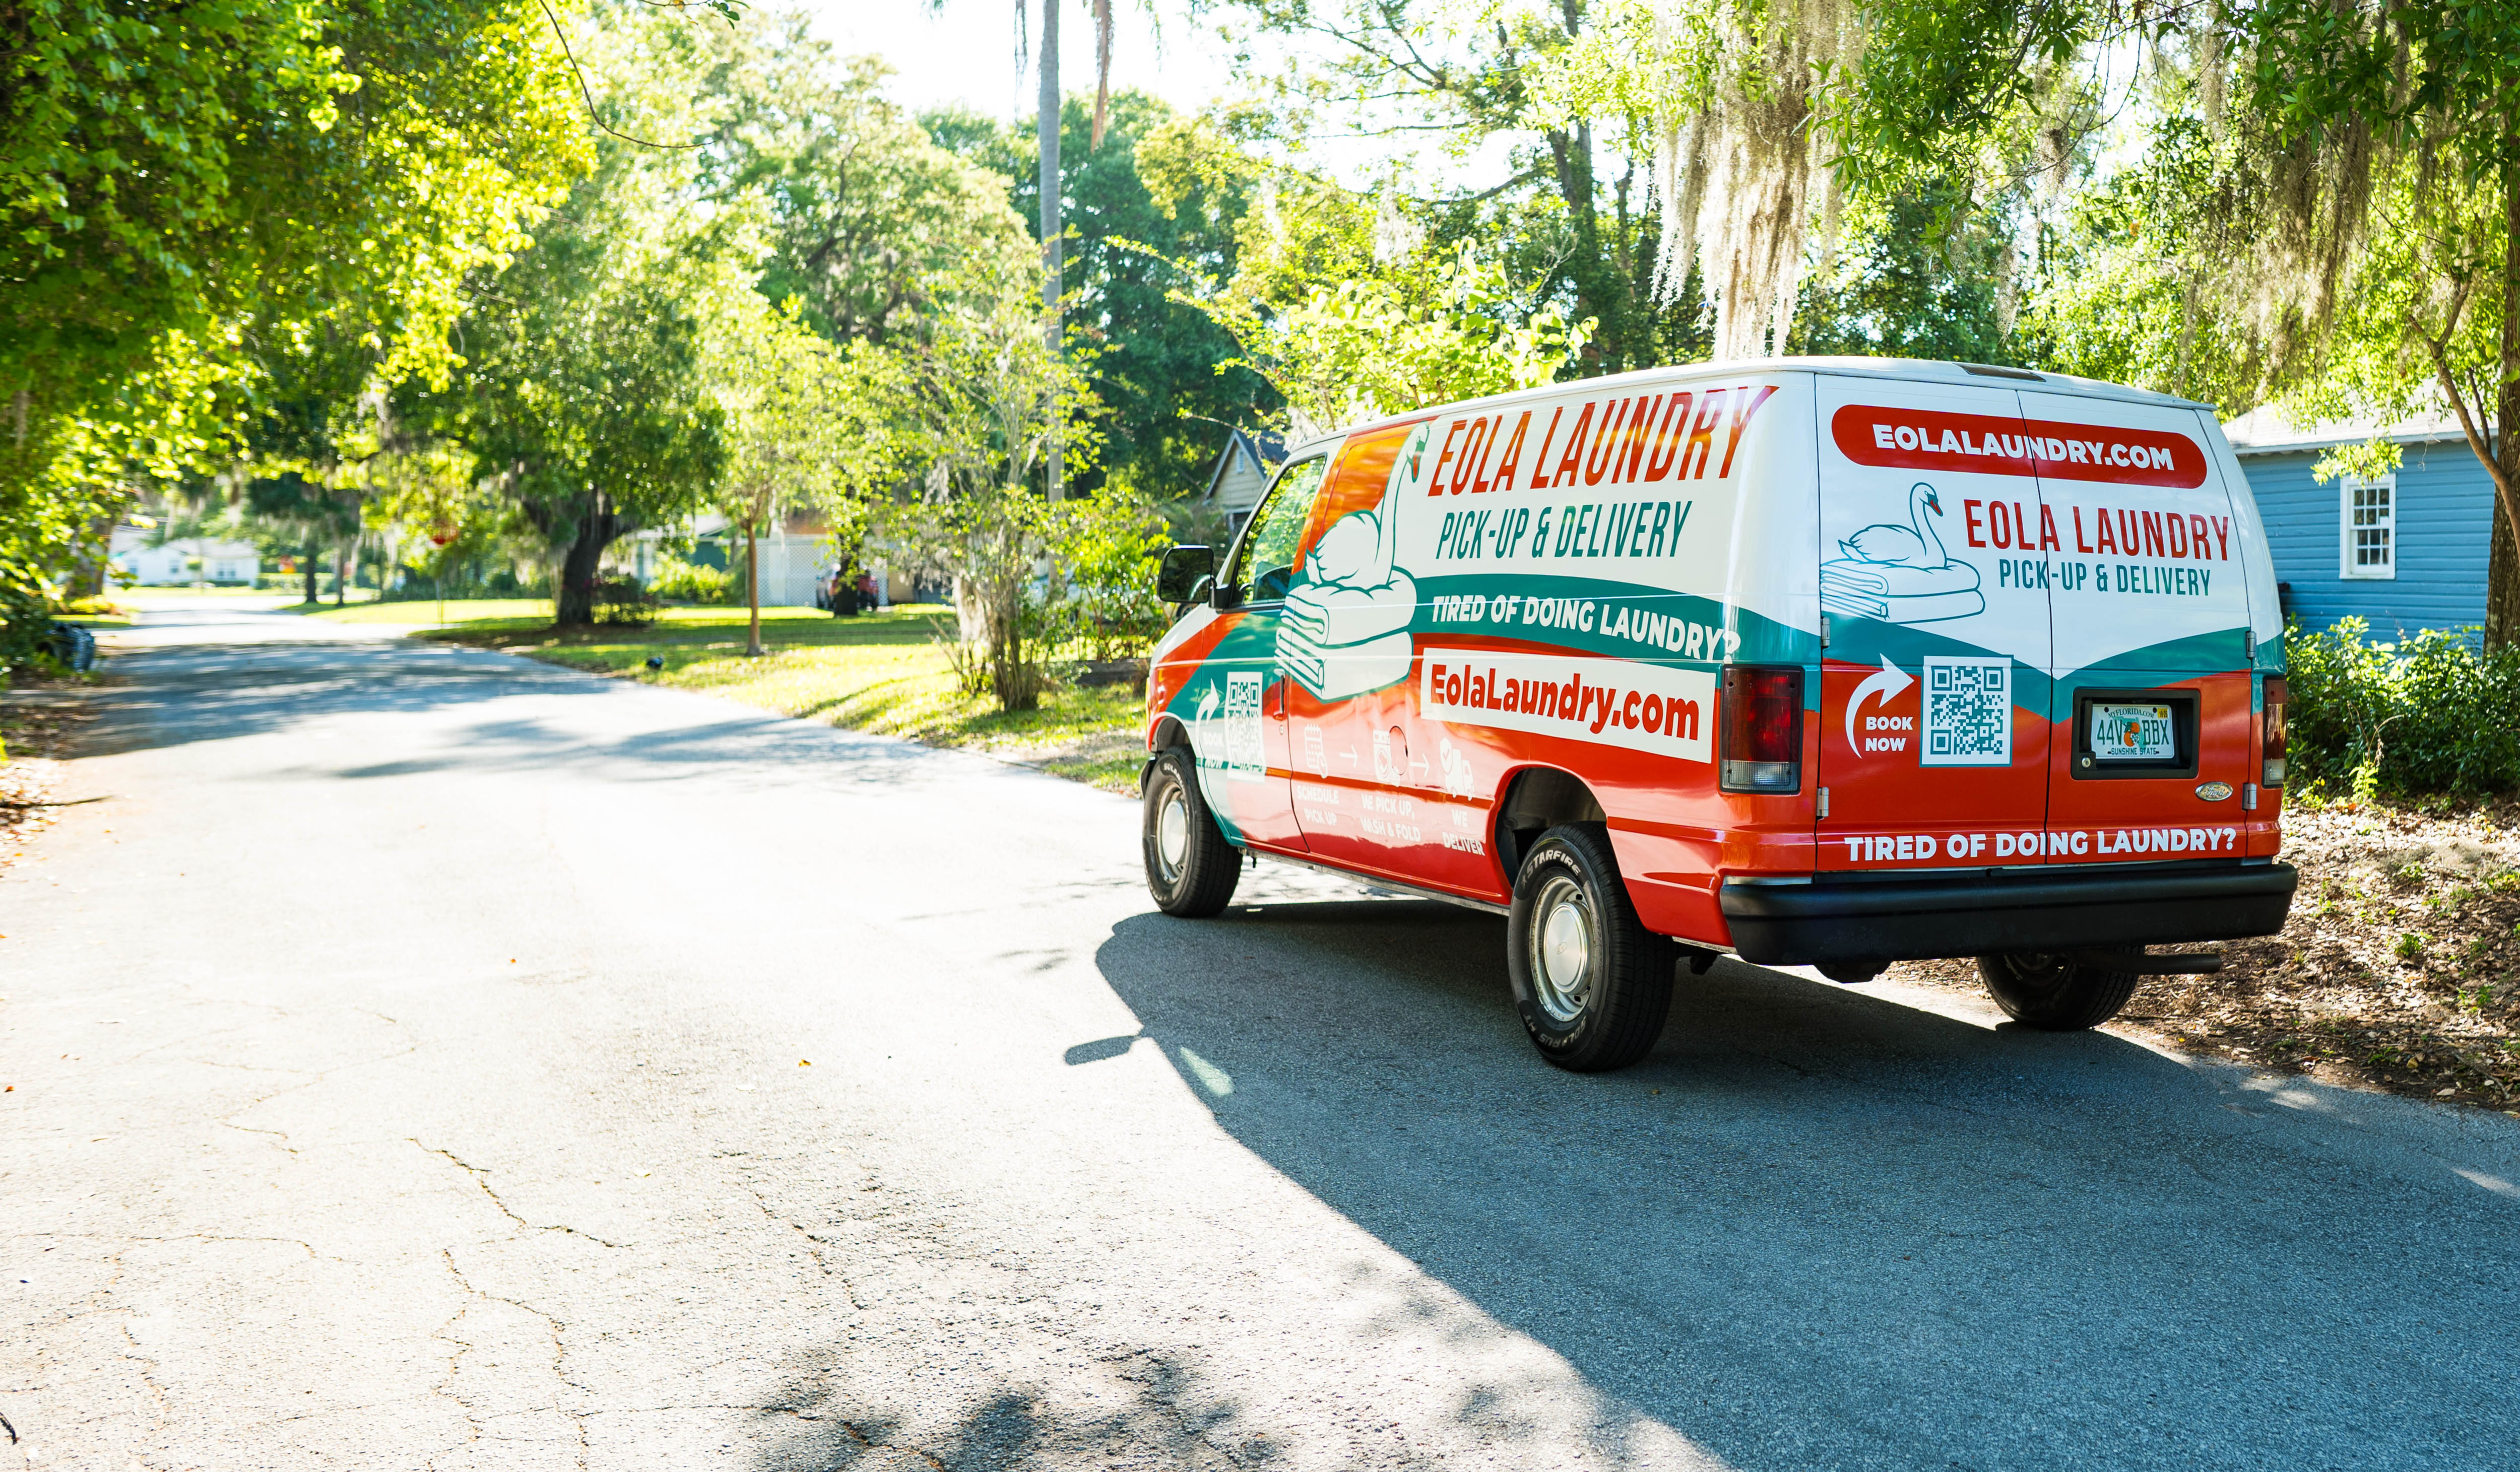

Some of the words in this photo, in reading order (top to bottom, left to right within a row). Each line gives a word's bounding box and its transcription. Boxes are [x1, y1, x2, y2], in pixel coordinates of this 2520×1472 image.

[1428, 411, 1532, 496] EOLA
[1530, 385, 1780, 489] LAUNDRY
[1872, 424, 2174, 471] EOLALAUNDRY.COM
[1436, 508, 1529, 559] PICK-UP
[1531, 506, 1552, 558] &
[1555, 501, 1693, 557] DELIVERY
[1963, 499, 2061, 552] EOLA
[2073, 506, 2229, 561] LAUNDRY
[1999, 559, 2087, 591] PICK-UP
[2096, 565, 2108, 592] &
[2117, 565, 2211, 596] DELIVERY
[1432, 595, 1485, 622] TIRED
[1491, 594, 1521, 624] OF
[1522, 596, 1595, 632] DOING
[1599, 605, 1741, 663] LAUNDRY?
[1431, 664, 1699, 741] EolaLaundry.com
[2108, 708, 2154, 718] MYFLORIDA.COM
[1866, 716, 1913, 730] BOOK
[2097, 719, 2123, 745] 44V
[2142, 720, 2169, 745] BBX
[1203, 732, 1224, 748] BOOK
[1865, 738, 1906, 751] NOW
[1205, 754, 1223, 769] NOW
[1297, 785, 1339, 805] SCHEDULE
[1361, 793, 1375, 810] WE
[1376, 796, 1397, 815] PICK
[1303, 808, 1324, 825] PICK
[1325, 811, 1337, 826] UP
[1361, 816, 1386, 835] WASH
[1386, 824, 1395, 837] &
[1395, 823, 1421, 842] FOLD
[1451, 808, 1468, 828] WE
[1442, 832, 1485, 856] DELIVER
[1844, 835, 1937, 862] TIRED
[1947, 833, 1990, 859] OF
[1995, 831, 2088, 856] DOING
[2097, 828, 2237, 854] LAUNDRY?
[1527, 849, 1581, 879] STARFIRE
